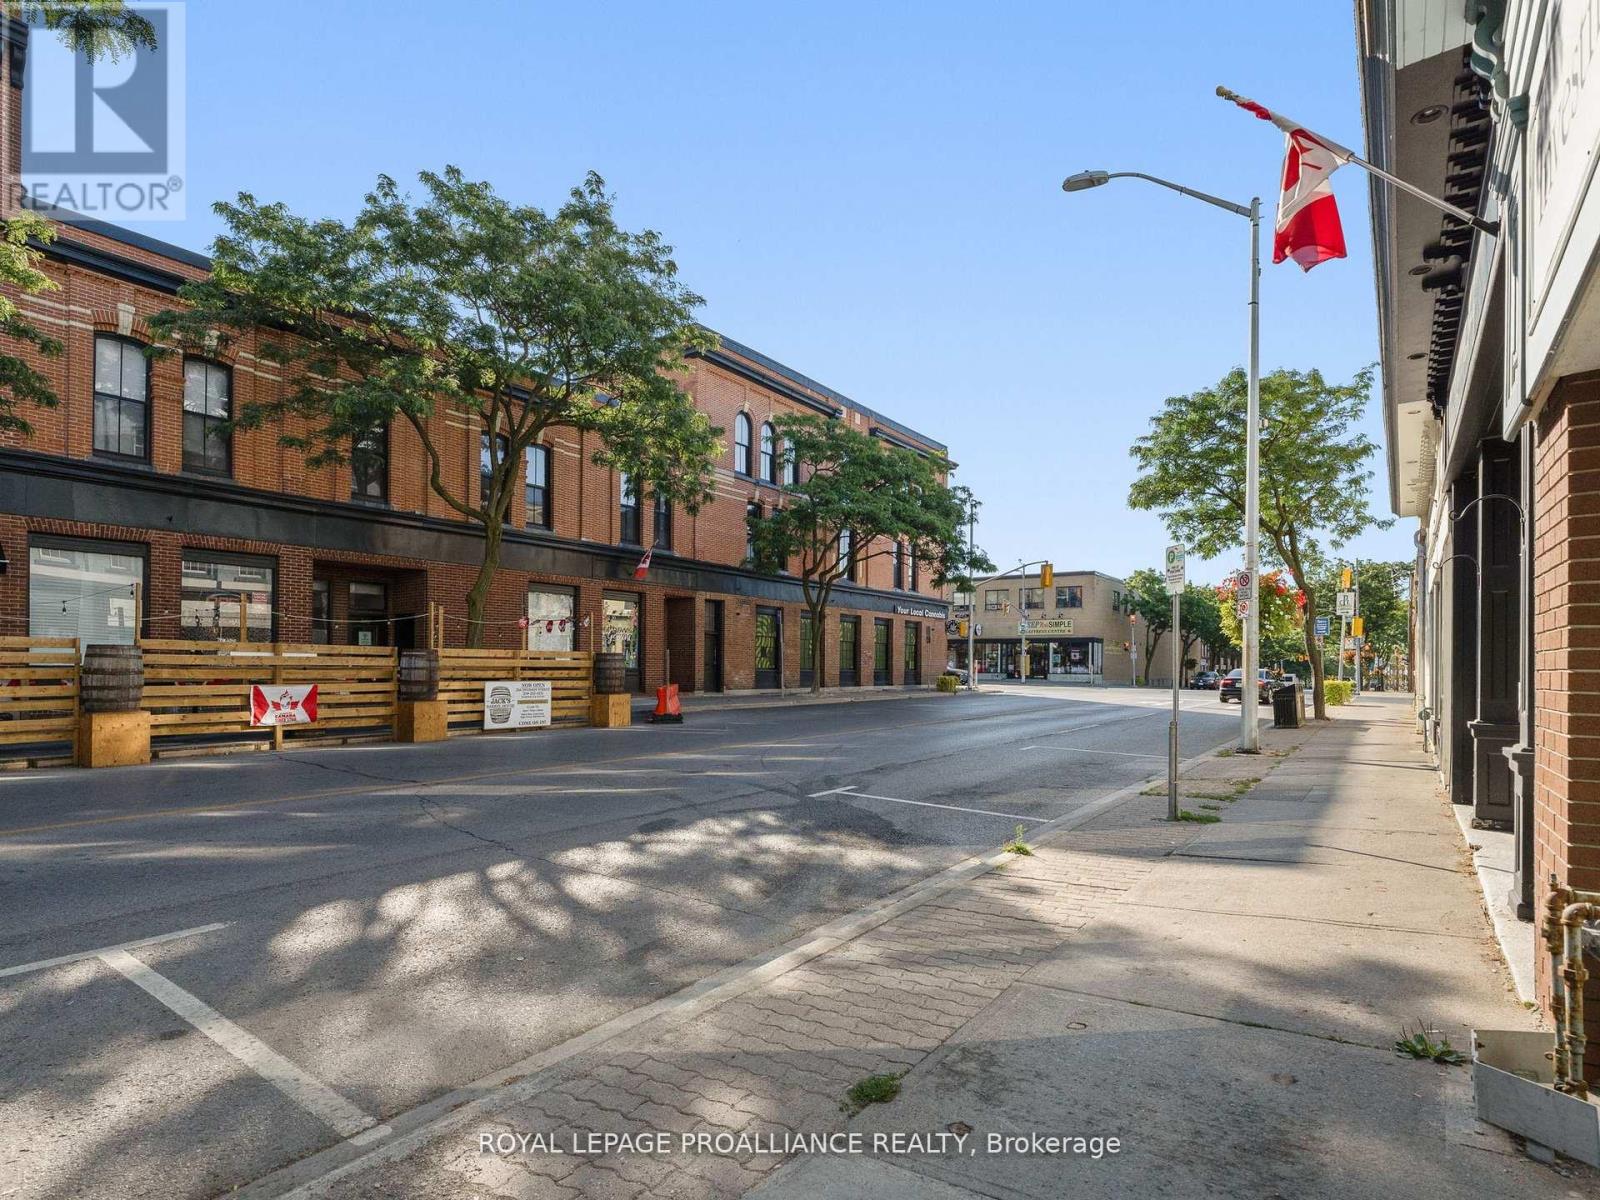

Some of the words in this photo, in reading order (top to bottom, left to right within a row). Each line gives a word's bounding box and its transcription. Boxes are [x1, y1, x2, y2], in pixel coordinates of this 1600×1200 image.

[897, 605, 909, 614] Your
[910, 607, 923, 616] Local
[1048, 620, 1072, 628] SIMPLE
